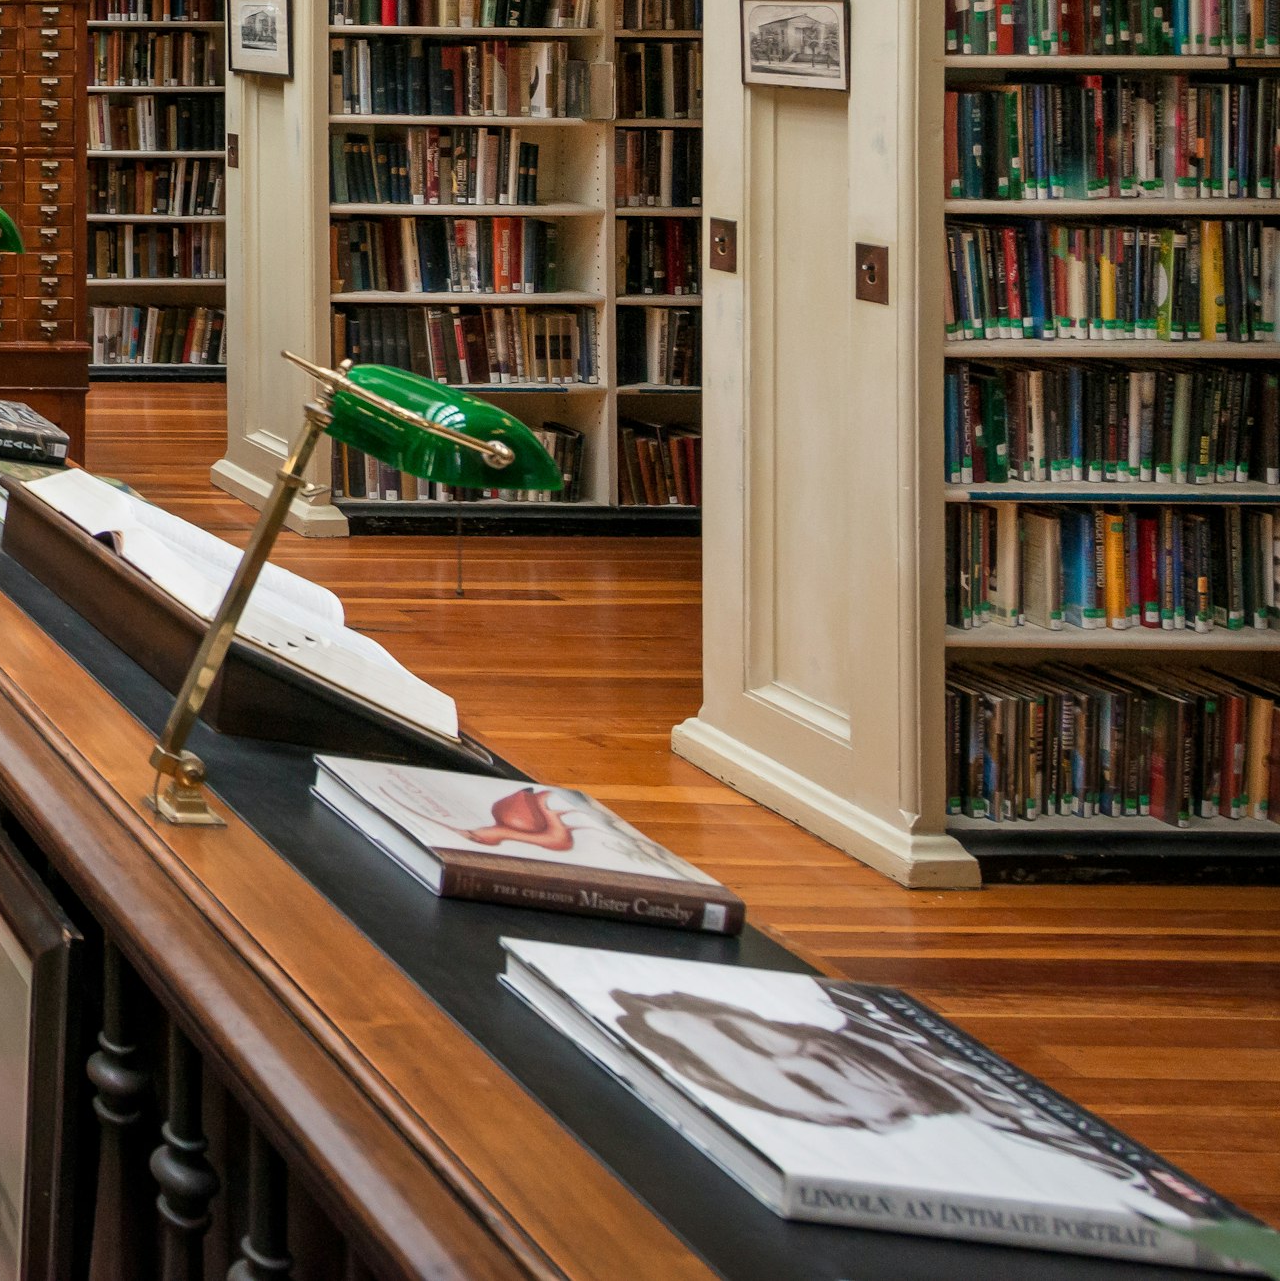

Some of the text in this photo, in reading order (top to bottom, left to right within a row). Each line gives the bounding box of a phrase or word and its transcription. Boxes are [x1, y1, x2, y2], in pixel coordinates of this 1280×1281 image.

[500, 230, 510, 275] Gettysburg
[1182, 737, 1193, 799] NEVADA BARR
[493, 883, 519, 896] THE
[521, 886, 577, 903] CURIOUS
[578, 890, 631, 912] Mister
[633, 897, 696, 926] Catesby
[903, 1201, 931, 1221] AN
[939, 1203, 1045, 1236] INTIMATE
[1051, 1214, 1161, 1251] PORTRAIT
